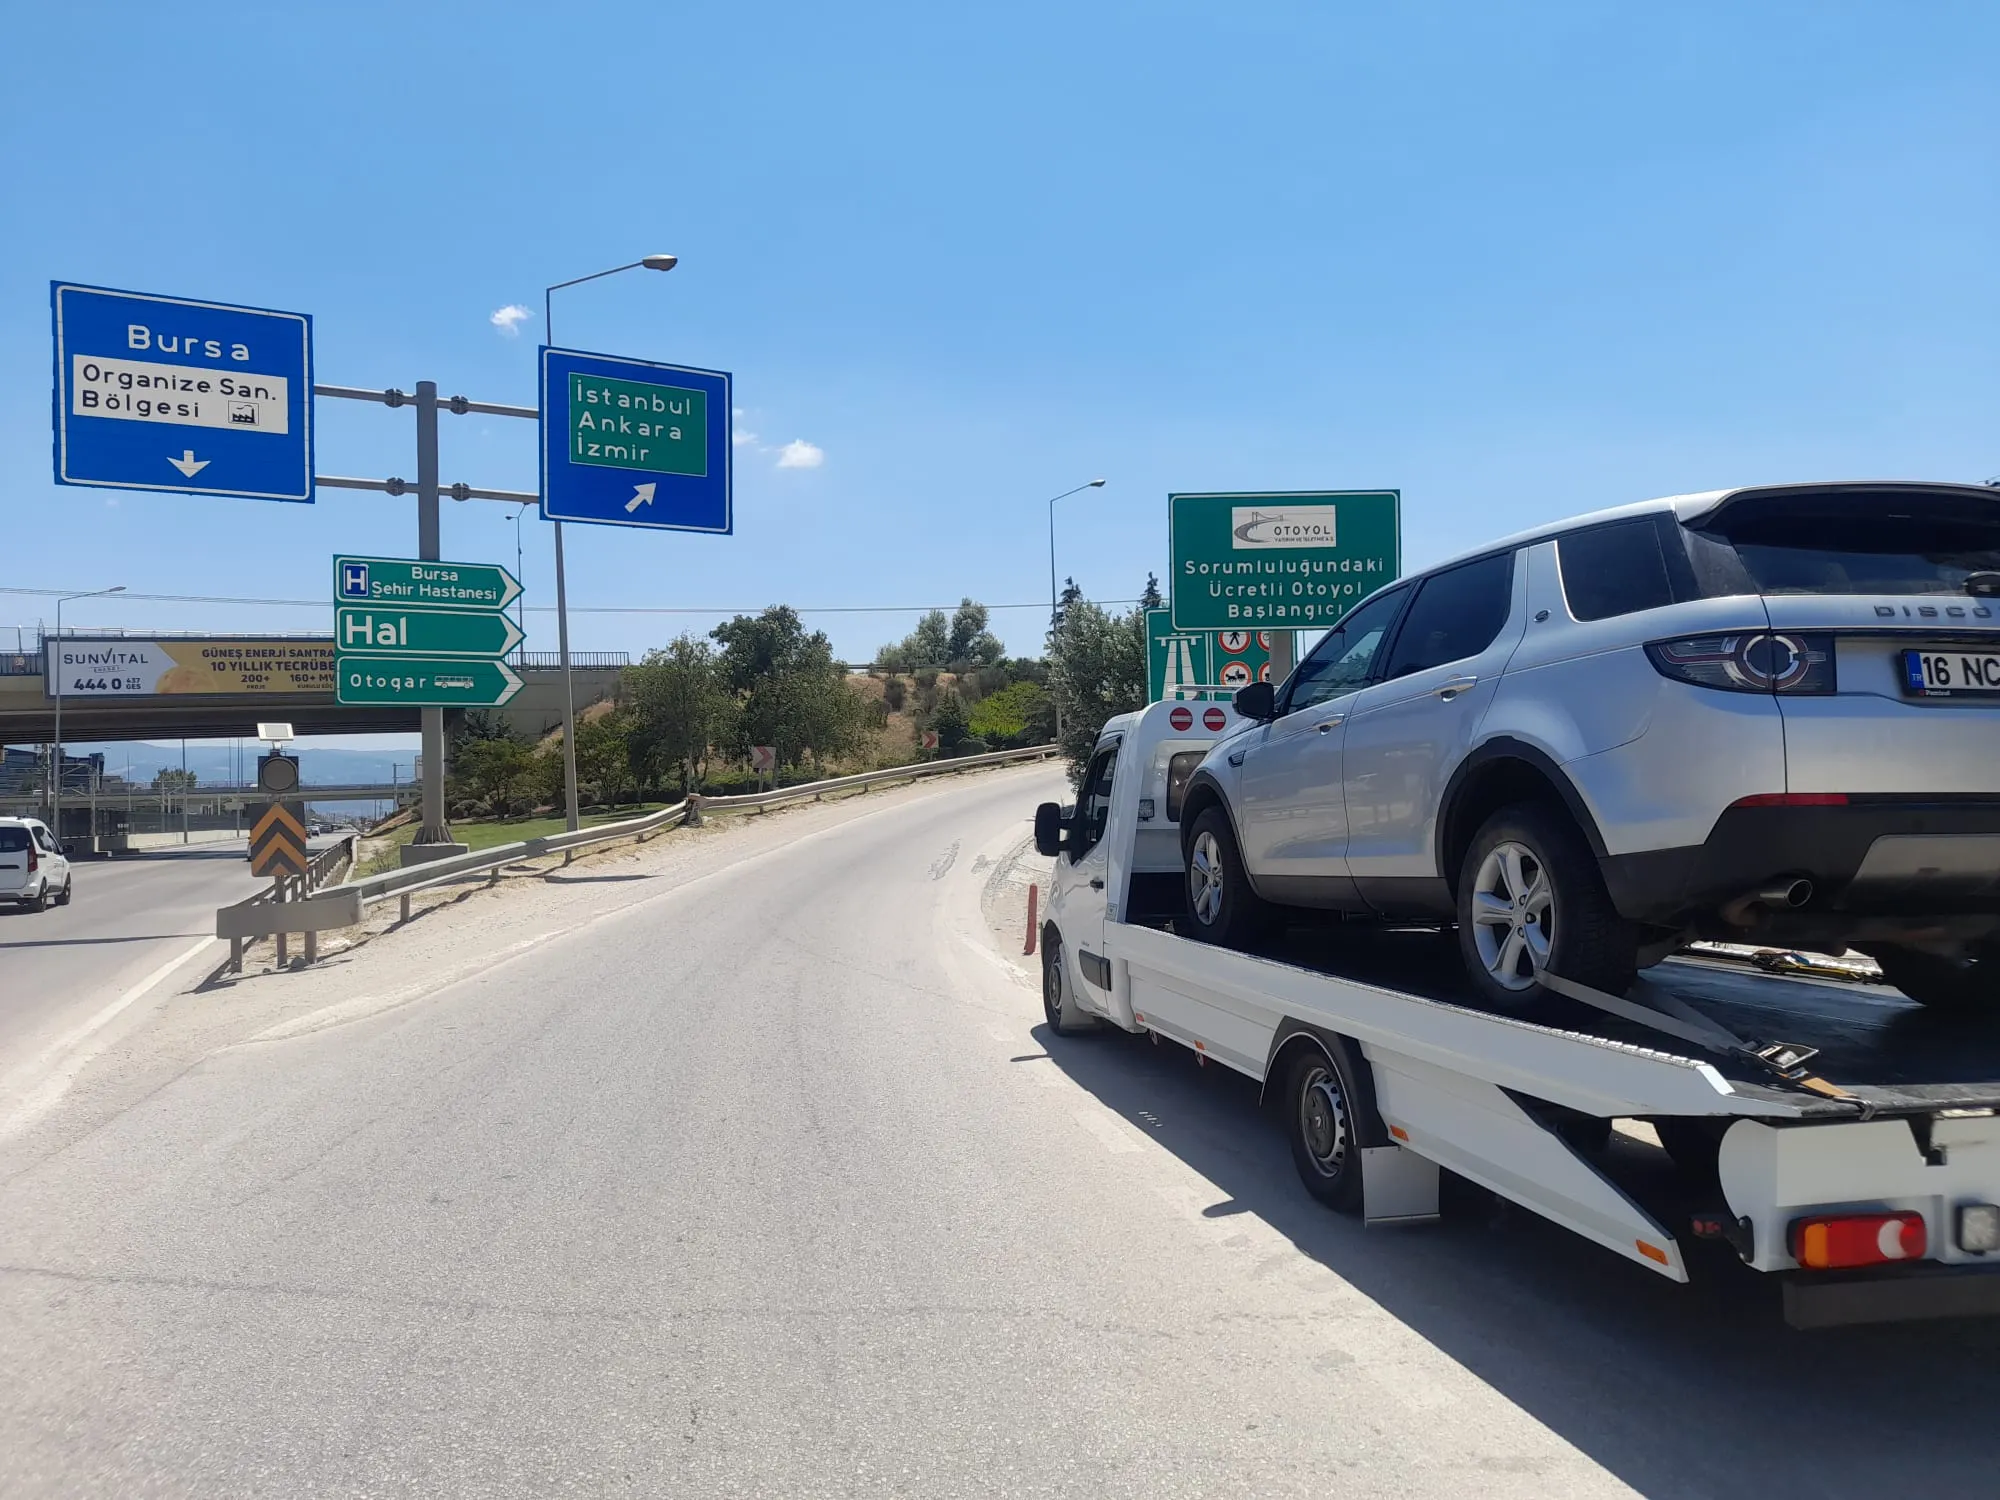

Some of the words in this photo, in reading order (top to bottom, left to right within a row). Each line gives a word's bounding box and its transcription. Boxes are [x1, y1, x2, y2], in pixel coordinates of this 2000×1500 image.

[128, 324, 250, 361] Bursa
[83, 364, 211, 393] Organize
[219, 378, 276, 401] San.
[82, 390, 199, 417] Bölgesi
[577, 379, 691, 416] İstanbul
[578, 411, 682, 440] Ankara
[577, 432, 650, 461] İzmir
[1274, 526, 1330, 536] OTOYOL
[411, 566, 458, 582] Bursa
[1185, 558, 1383, 577] Sorumluluğundaki
[346, 569, 366, 591] H
[1209, 580, 1283, 597] Ücretli
[1291, 582, 1361, 598] Otoyol
[372, 581, 414, 598] Şehir
[419, 584, 497, 600] Hastanesi
[1228, 604, 1343, 620] Başlangıcı
[1874, 605, 2000, 618] DISCO
[345, 614, 407, 646] Hal
[64, 648, 149, 664] SUNVITAL
[202, 647, 243, 659] GÜNEŞ
[245, 646, 286, 658] ENERJİ
[211, 661, 226, 671] 10
[229, 661, 273, 671] YILLIK
[1923, 656, 1951, 686] 16
[1961, 657, 2000, 687] NC
[74, 678, 107, 690] 444
[112, 678, 122, 690] 0
[240, 674, 270, 683] 200+
[290, 674, 316, 682] 160+
[350, 673, 427, 692] Otogar
